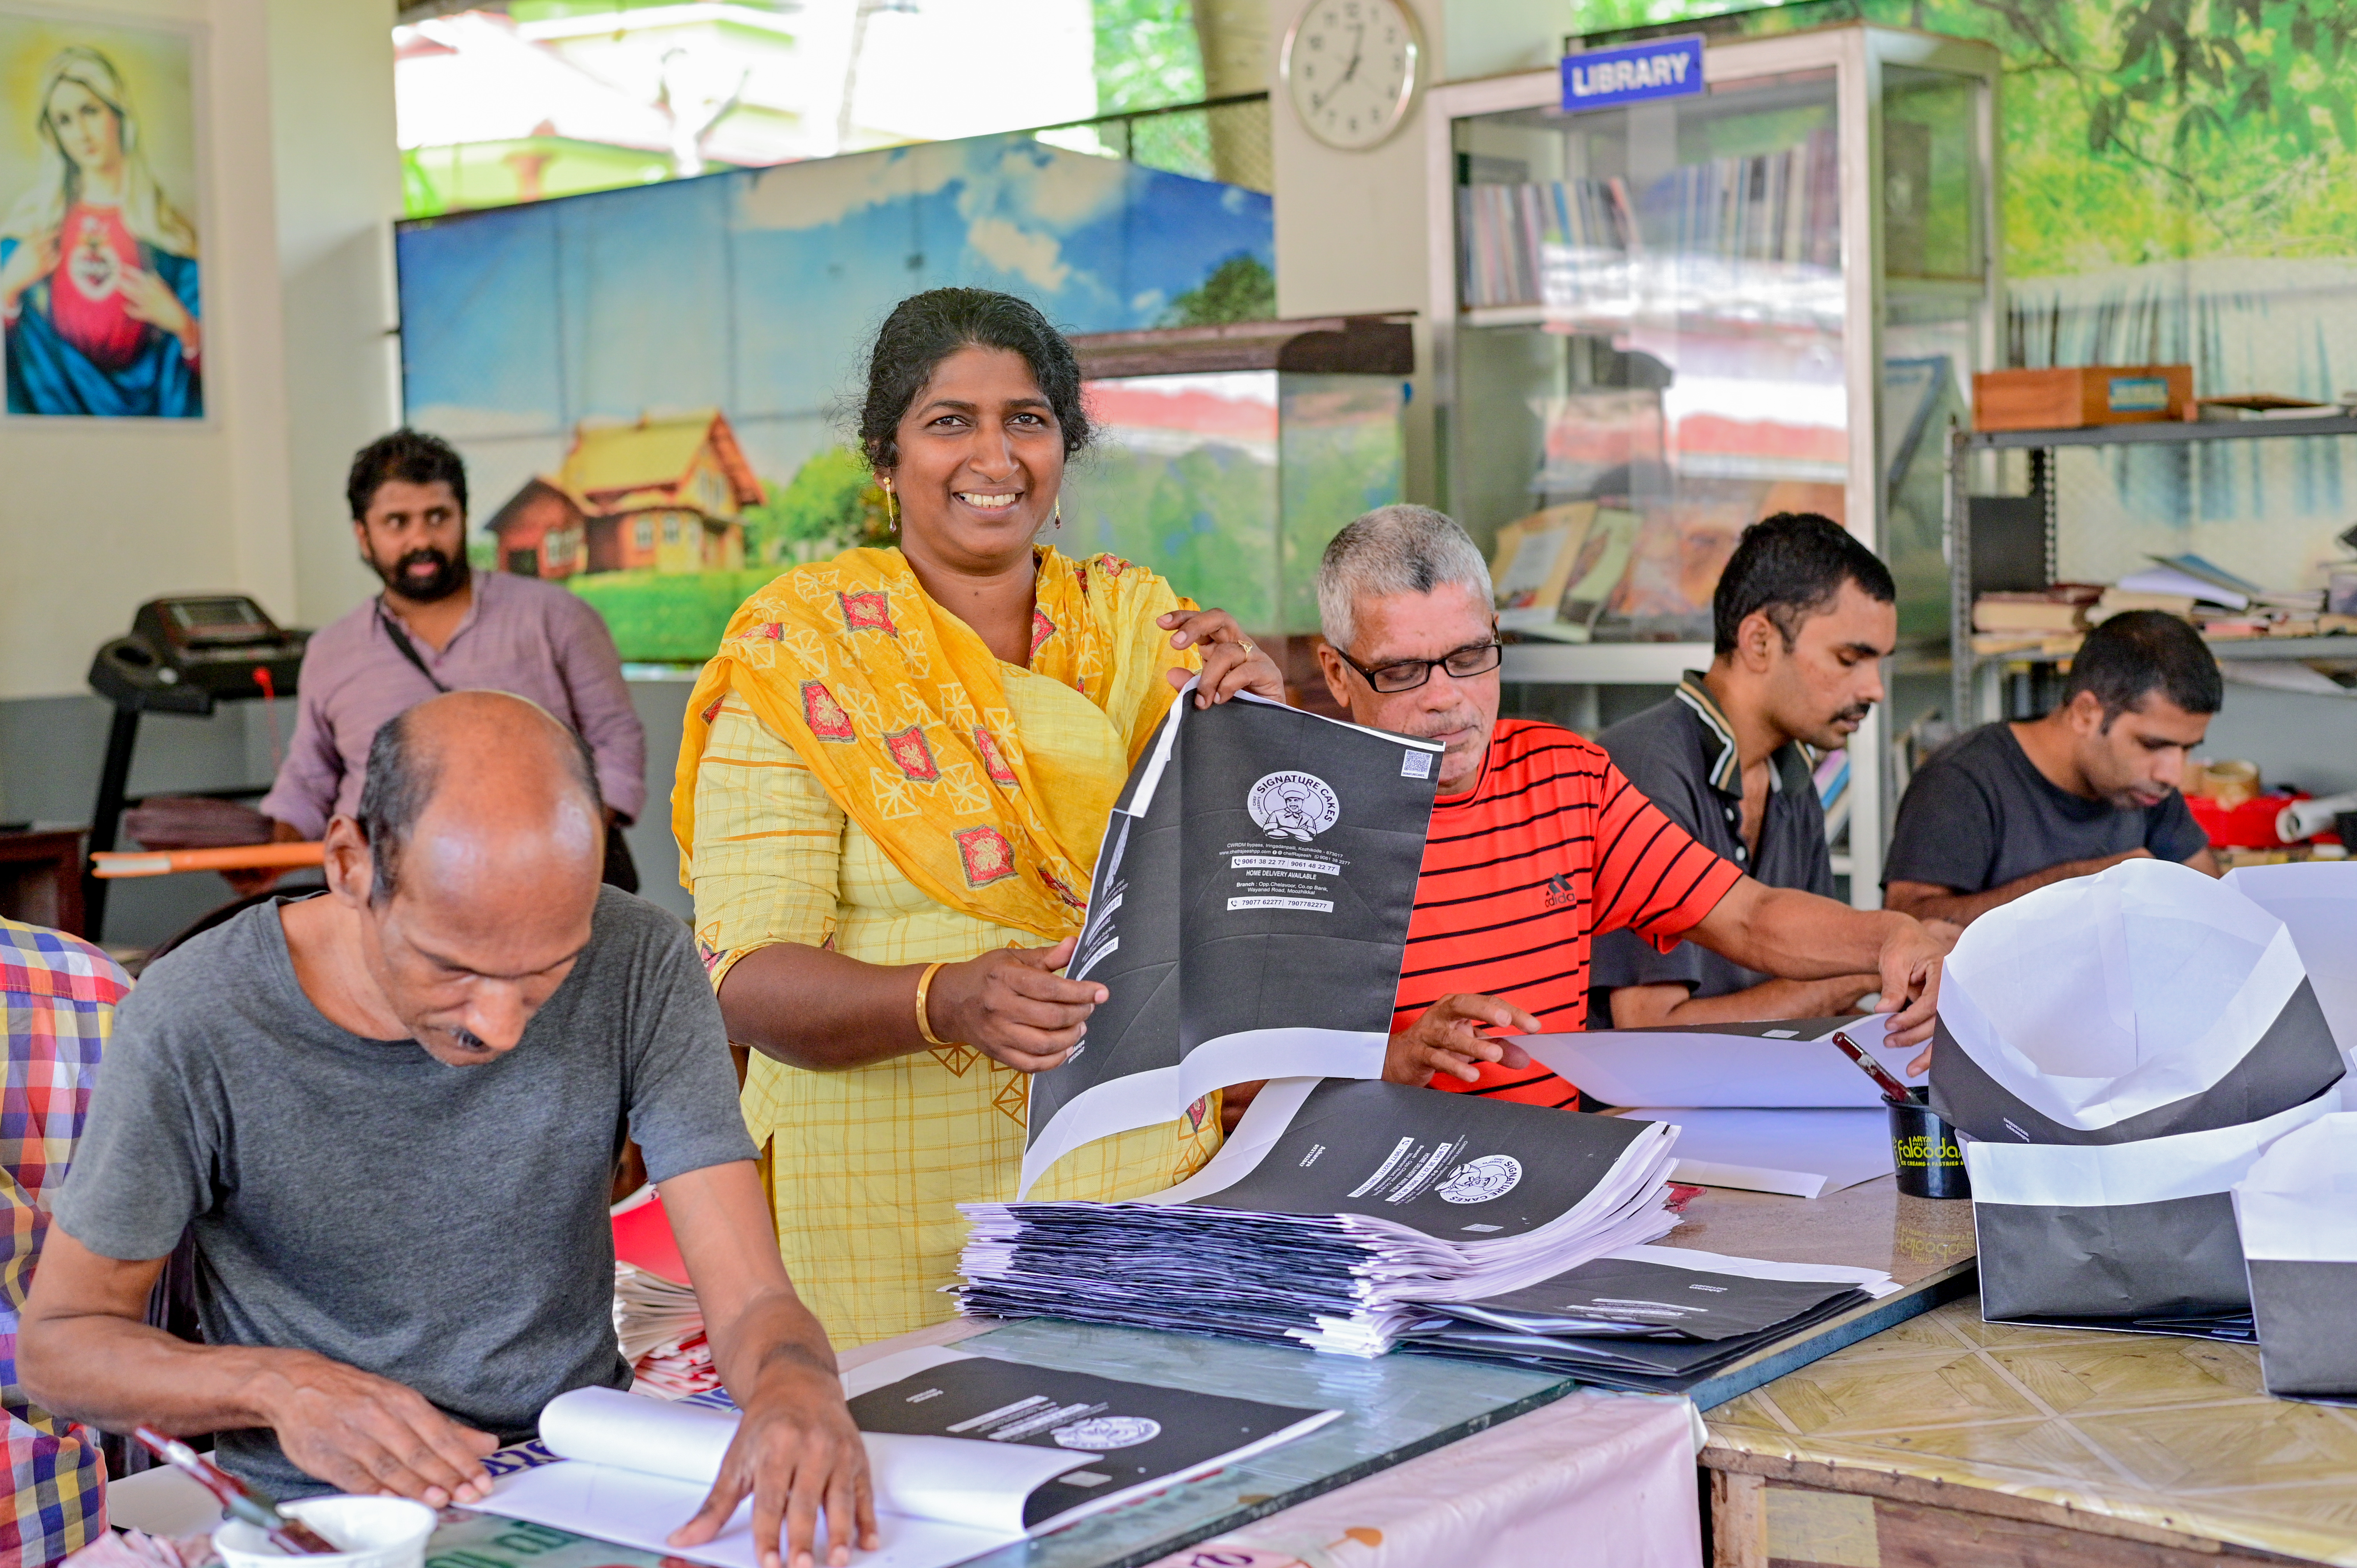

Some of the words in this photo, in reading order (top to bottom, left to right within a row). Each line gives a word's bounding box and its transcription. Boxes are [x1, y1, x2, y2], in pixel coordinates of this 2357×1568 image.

[1572, 51, 1690, 97] LIBRARY
[1257, 775, 1321, 793] SIGNATURE
[1320, 788, 1336, 822] CAKES
[1288, 901, 1327, 909] 7907782277
[1299, 1144, 1320, 1167] 8921262847
[1391, 1148, 1403, 1162] 79077
[1412, 1145, 1424, 1158] Branch
[1433, 1150, 1444, 1161] 9061
[1898, 1136, 1960, 1161] falooda
[1305, 1146, 1326, 1167] Asharaya
[1419, 1153, 1431, 1164] HOME
[1380, 1162, 1392, 1174] 62277
[1405, 1163, 1422, 1179] DELIVERY
[1354, 1176, 1380, 1195] 7907782277
[1389, 1177, 1408, 1192] AVAILABLE
[1409, 1180, 1419, 1188] 9061
[1489, 1161, 1517, 1196] SIGNATURE
